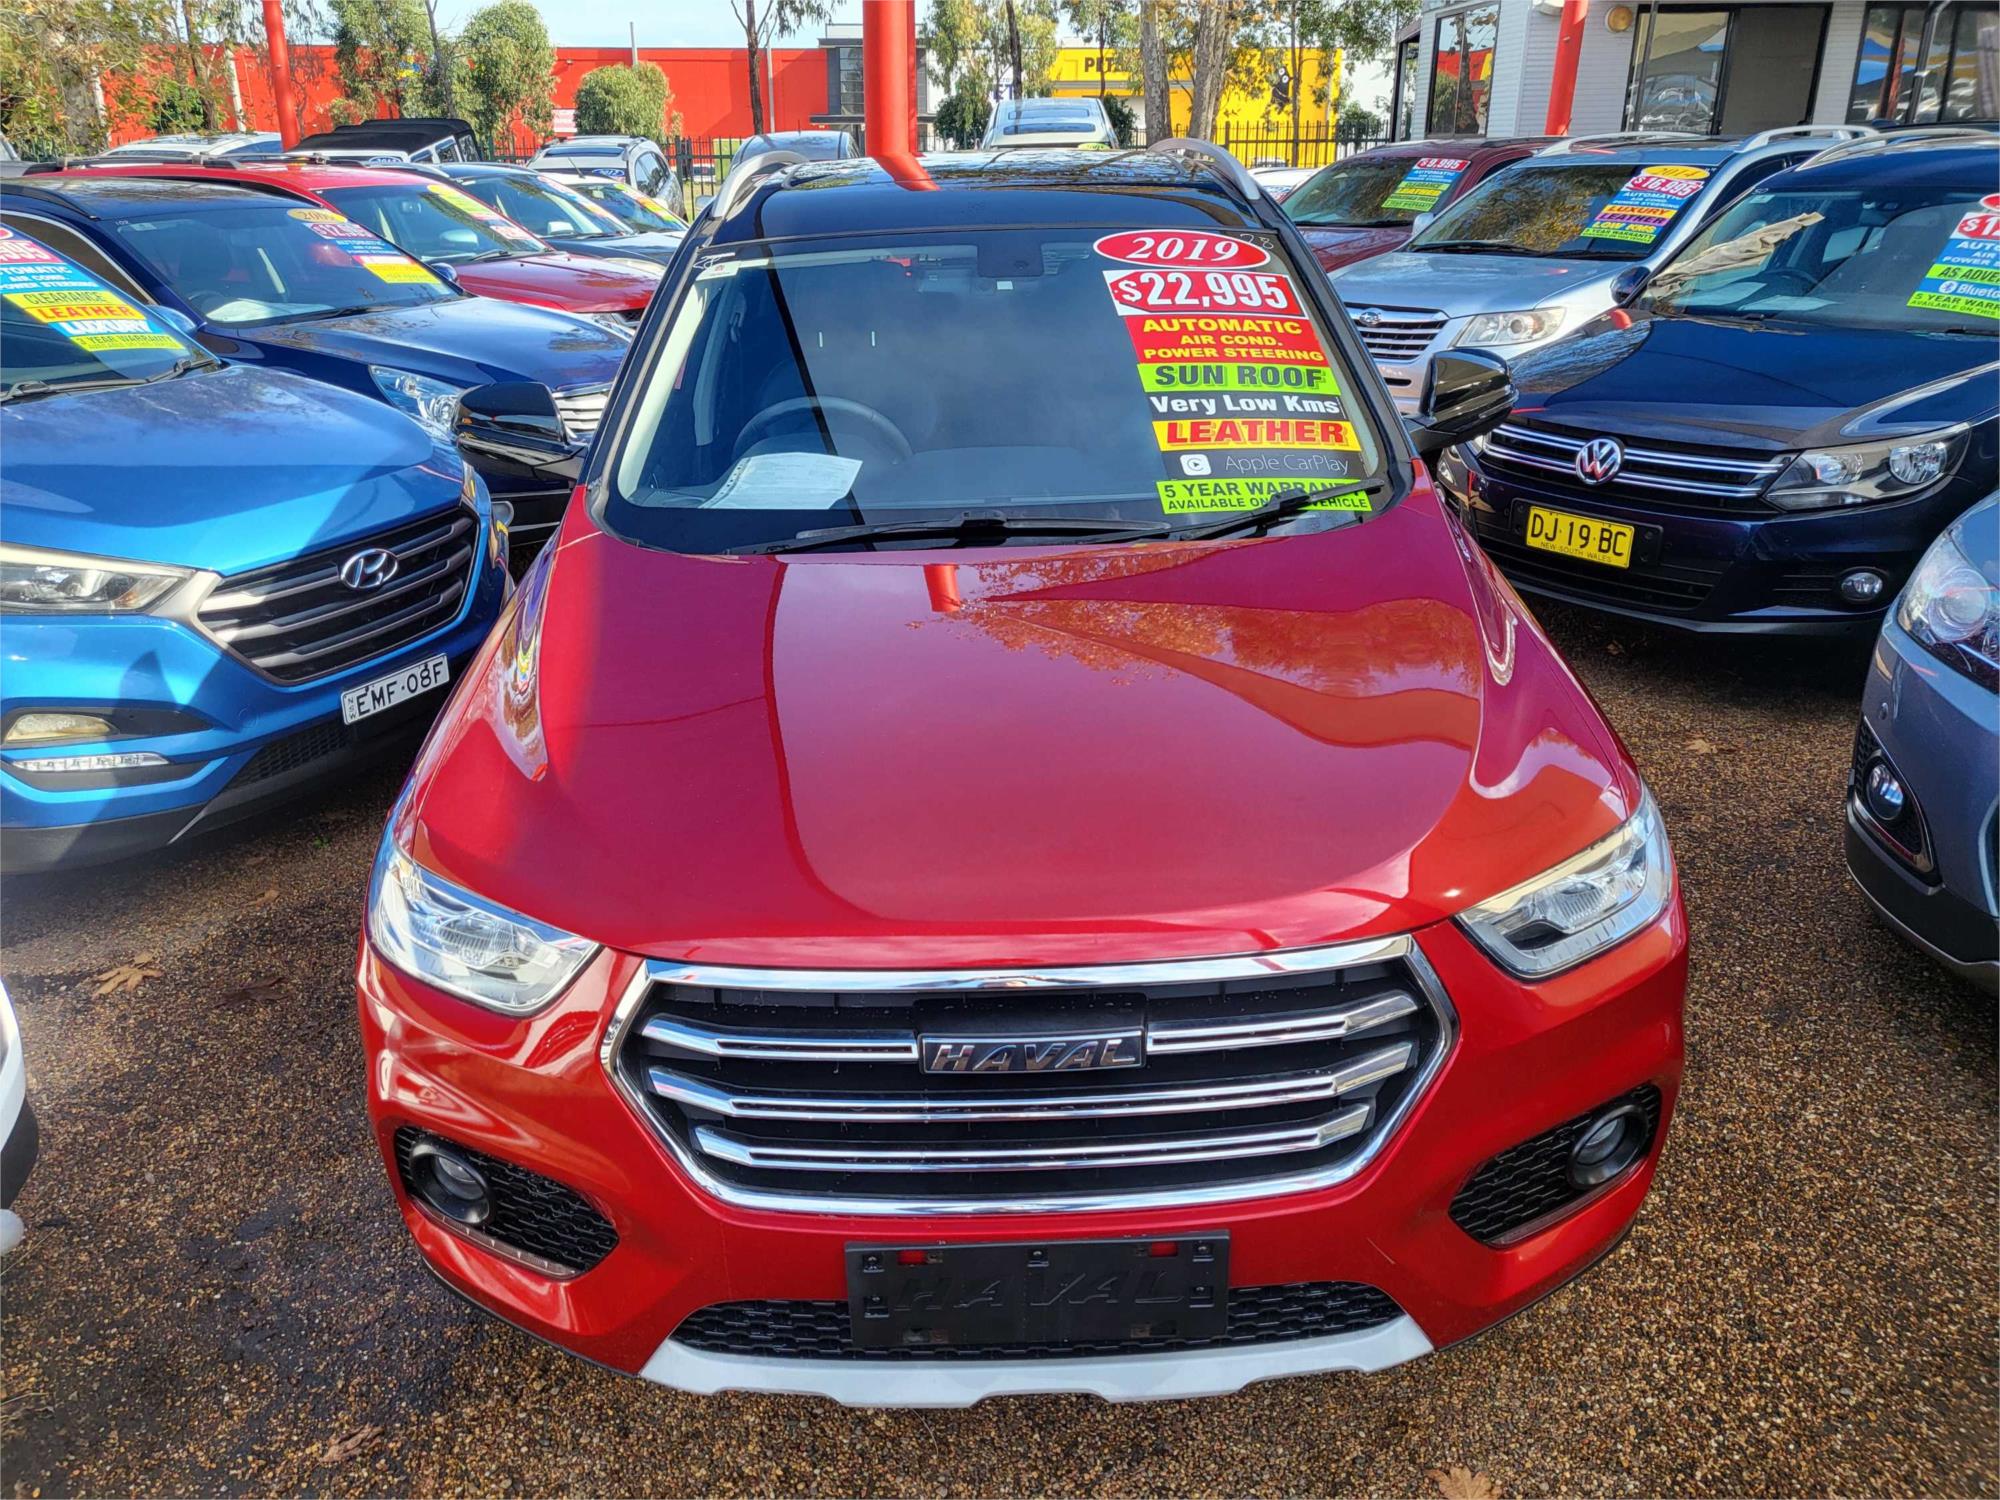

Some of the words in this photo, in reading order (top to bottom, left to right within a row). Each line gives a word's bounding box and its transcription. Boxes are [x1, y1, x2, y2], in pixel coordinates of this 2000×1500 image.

[1633, 176, 1693, 195] $16,995
[1608, 205, 1670, 216] LUXURY
[1599, 213, 1667, 225] LEATHER
[1126, 236, 1240, 262] 2019
[1972, 251, 1997, 260] AIR
[1941, 256, 1992, 267] POWER
[1937, 266, 1959, 277] AS
[23, 291, 106, 304] CLEARANCE
[1118, 272, 1288, 309] $22,995
[1911, 300, 1958, 310] AVAILABLE
[1927, 294, 1962, 305] YEAR
[37, 305, 135, 319] LEATHER
[57, 319, 153, 334] LUXURY
[1143, 318, 1303, 335] AUTOMATIC
[87, 335, 114, 344] YEAR
[1180, 335, 1217, 345] AIR
[1220, 335, 1284, 347] COND.
[1143, 347, 1219, 360] POWER
[1223, 347, 1325, 361] STEERING
[1155, 364, 1227, 388] SUN
[1237, 365, 1325, 389] ROOF
[1150, 395, 1216, 416] Very
[1222, 394, 1278, 412] Low
[1282, 395, 1341, 414] Kms
[1166, 419, 1347, 446] LEATHER
[1225, 454, 1280, 474] Apple
[1282, 454, 1350, 474] CarPlay
[1164, 484, 1177, 498] 5
[1183, 482, 1242, 497] YEAR
[1246, 481, 1360, 497] WARRAN
[1168, 498, 1247, 510] AVAILABLE
[1541, 541, 1557, 551] NEW
[1559, 546, 1584, 557] SOUTH
[1586, 552, 1613, 563] WALES
[930, 1038, 1137, 1072] HAVAL
[893, 1269, 1186, 1312] HAVAL
